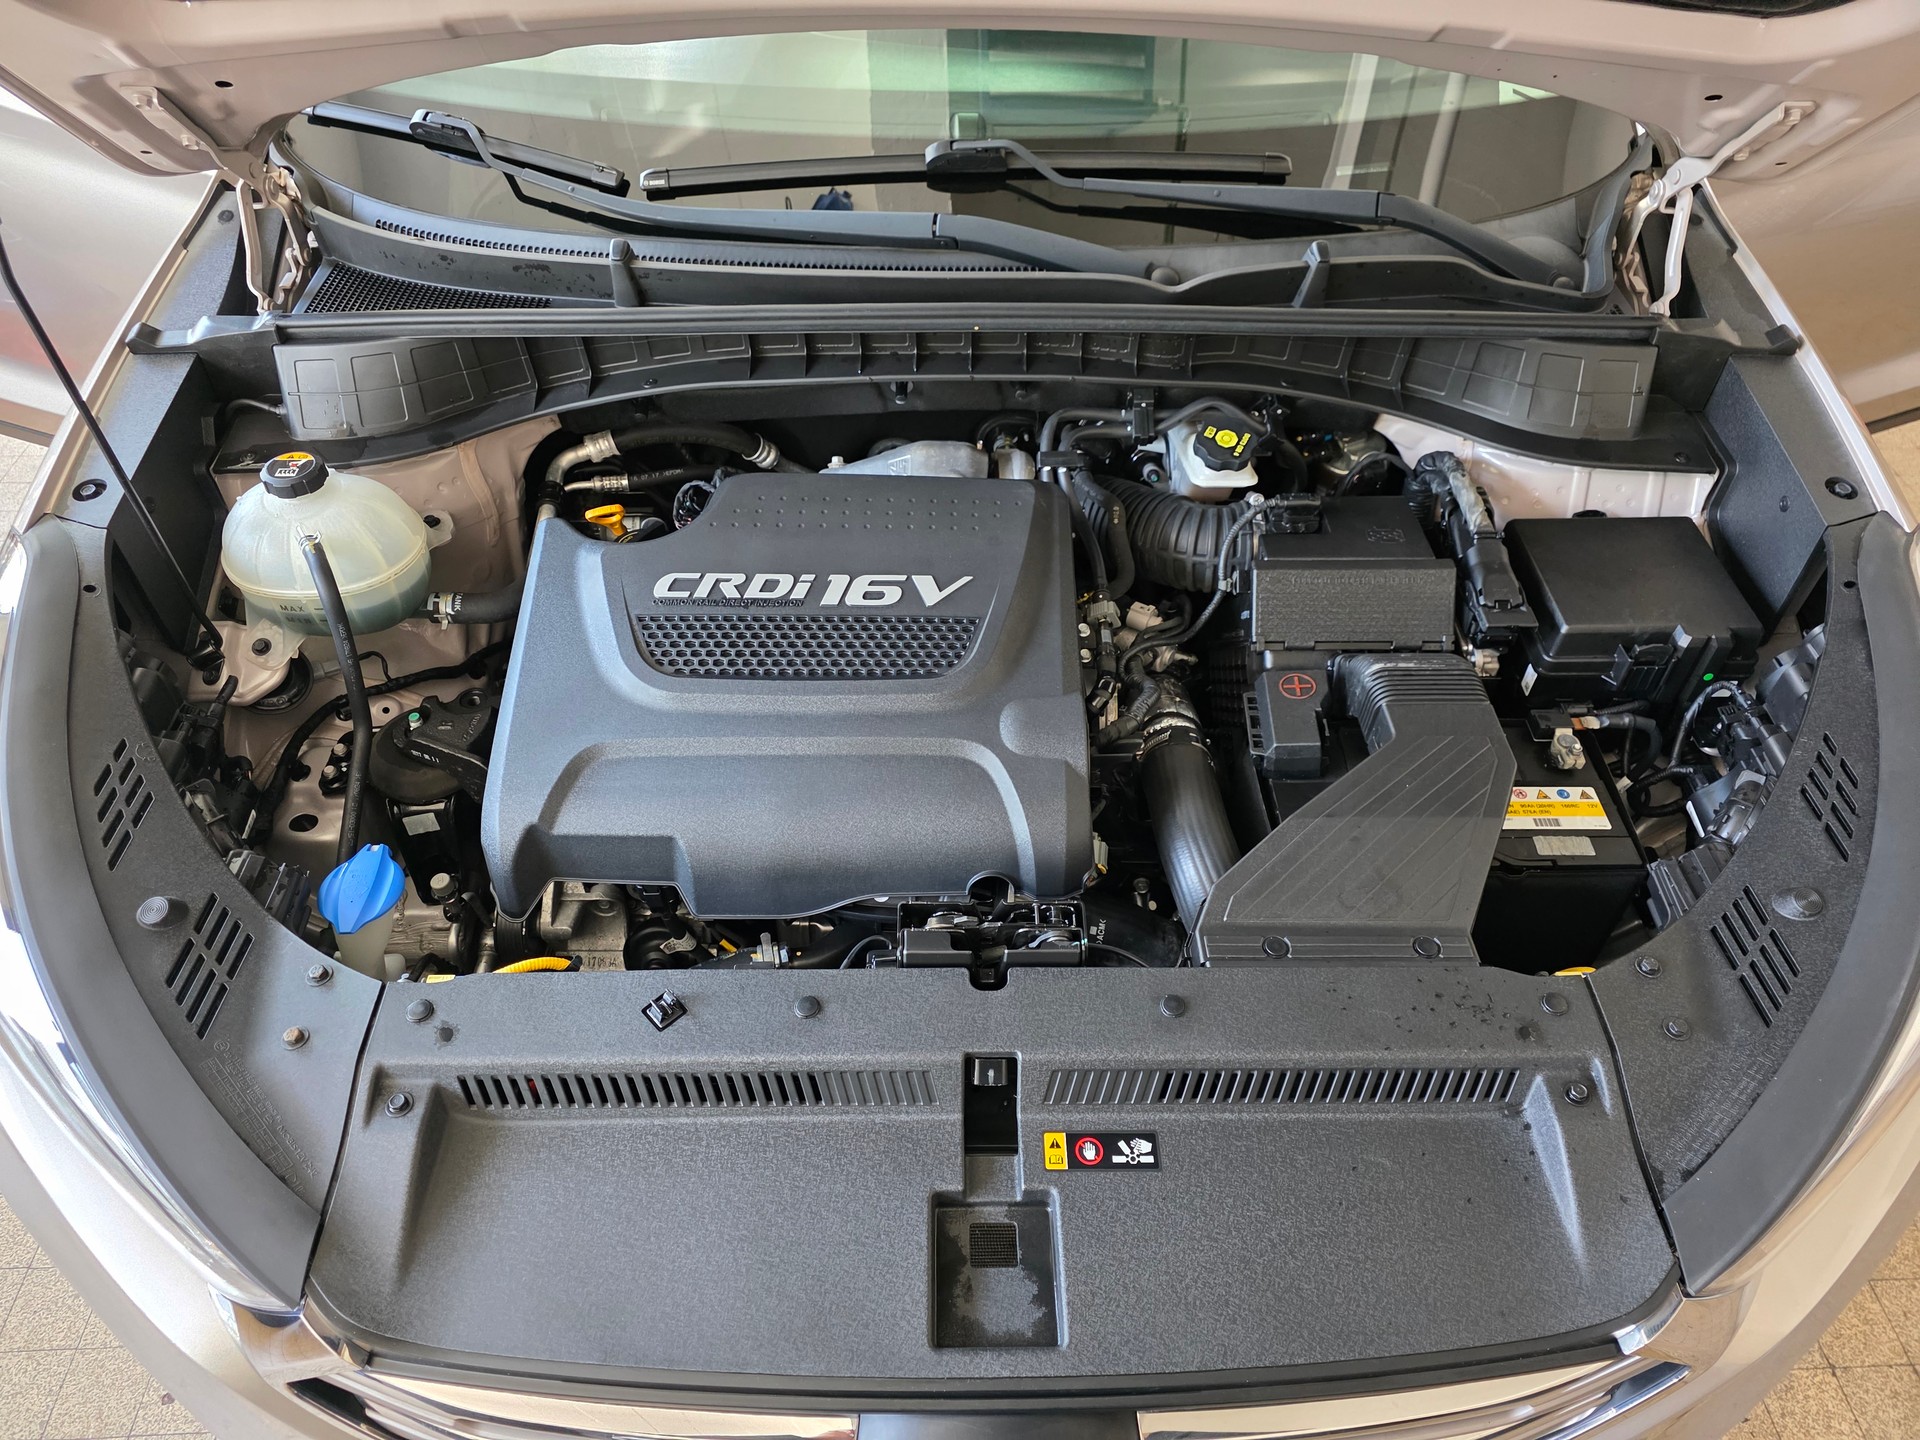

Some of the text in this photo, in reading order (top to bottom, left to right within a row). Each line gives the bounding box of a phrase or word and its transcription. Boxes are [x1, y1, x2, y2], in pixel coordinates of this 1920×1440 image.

[652, 571, 974, 607] CRDi 16V
[279, 604, 305, 612] MAX
[652, 599, 804, 608] COMMON RAIL DIRECT INJECTION
